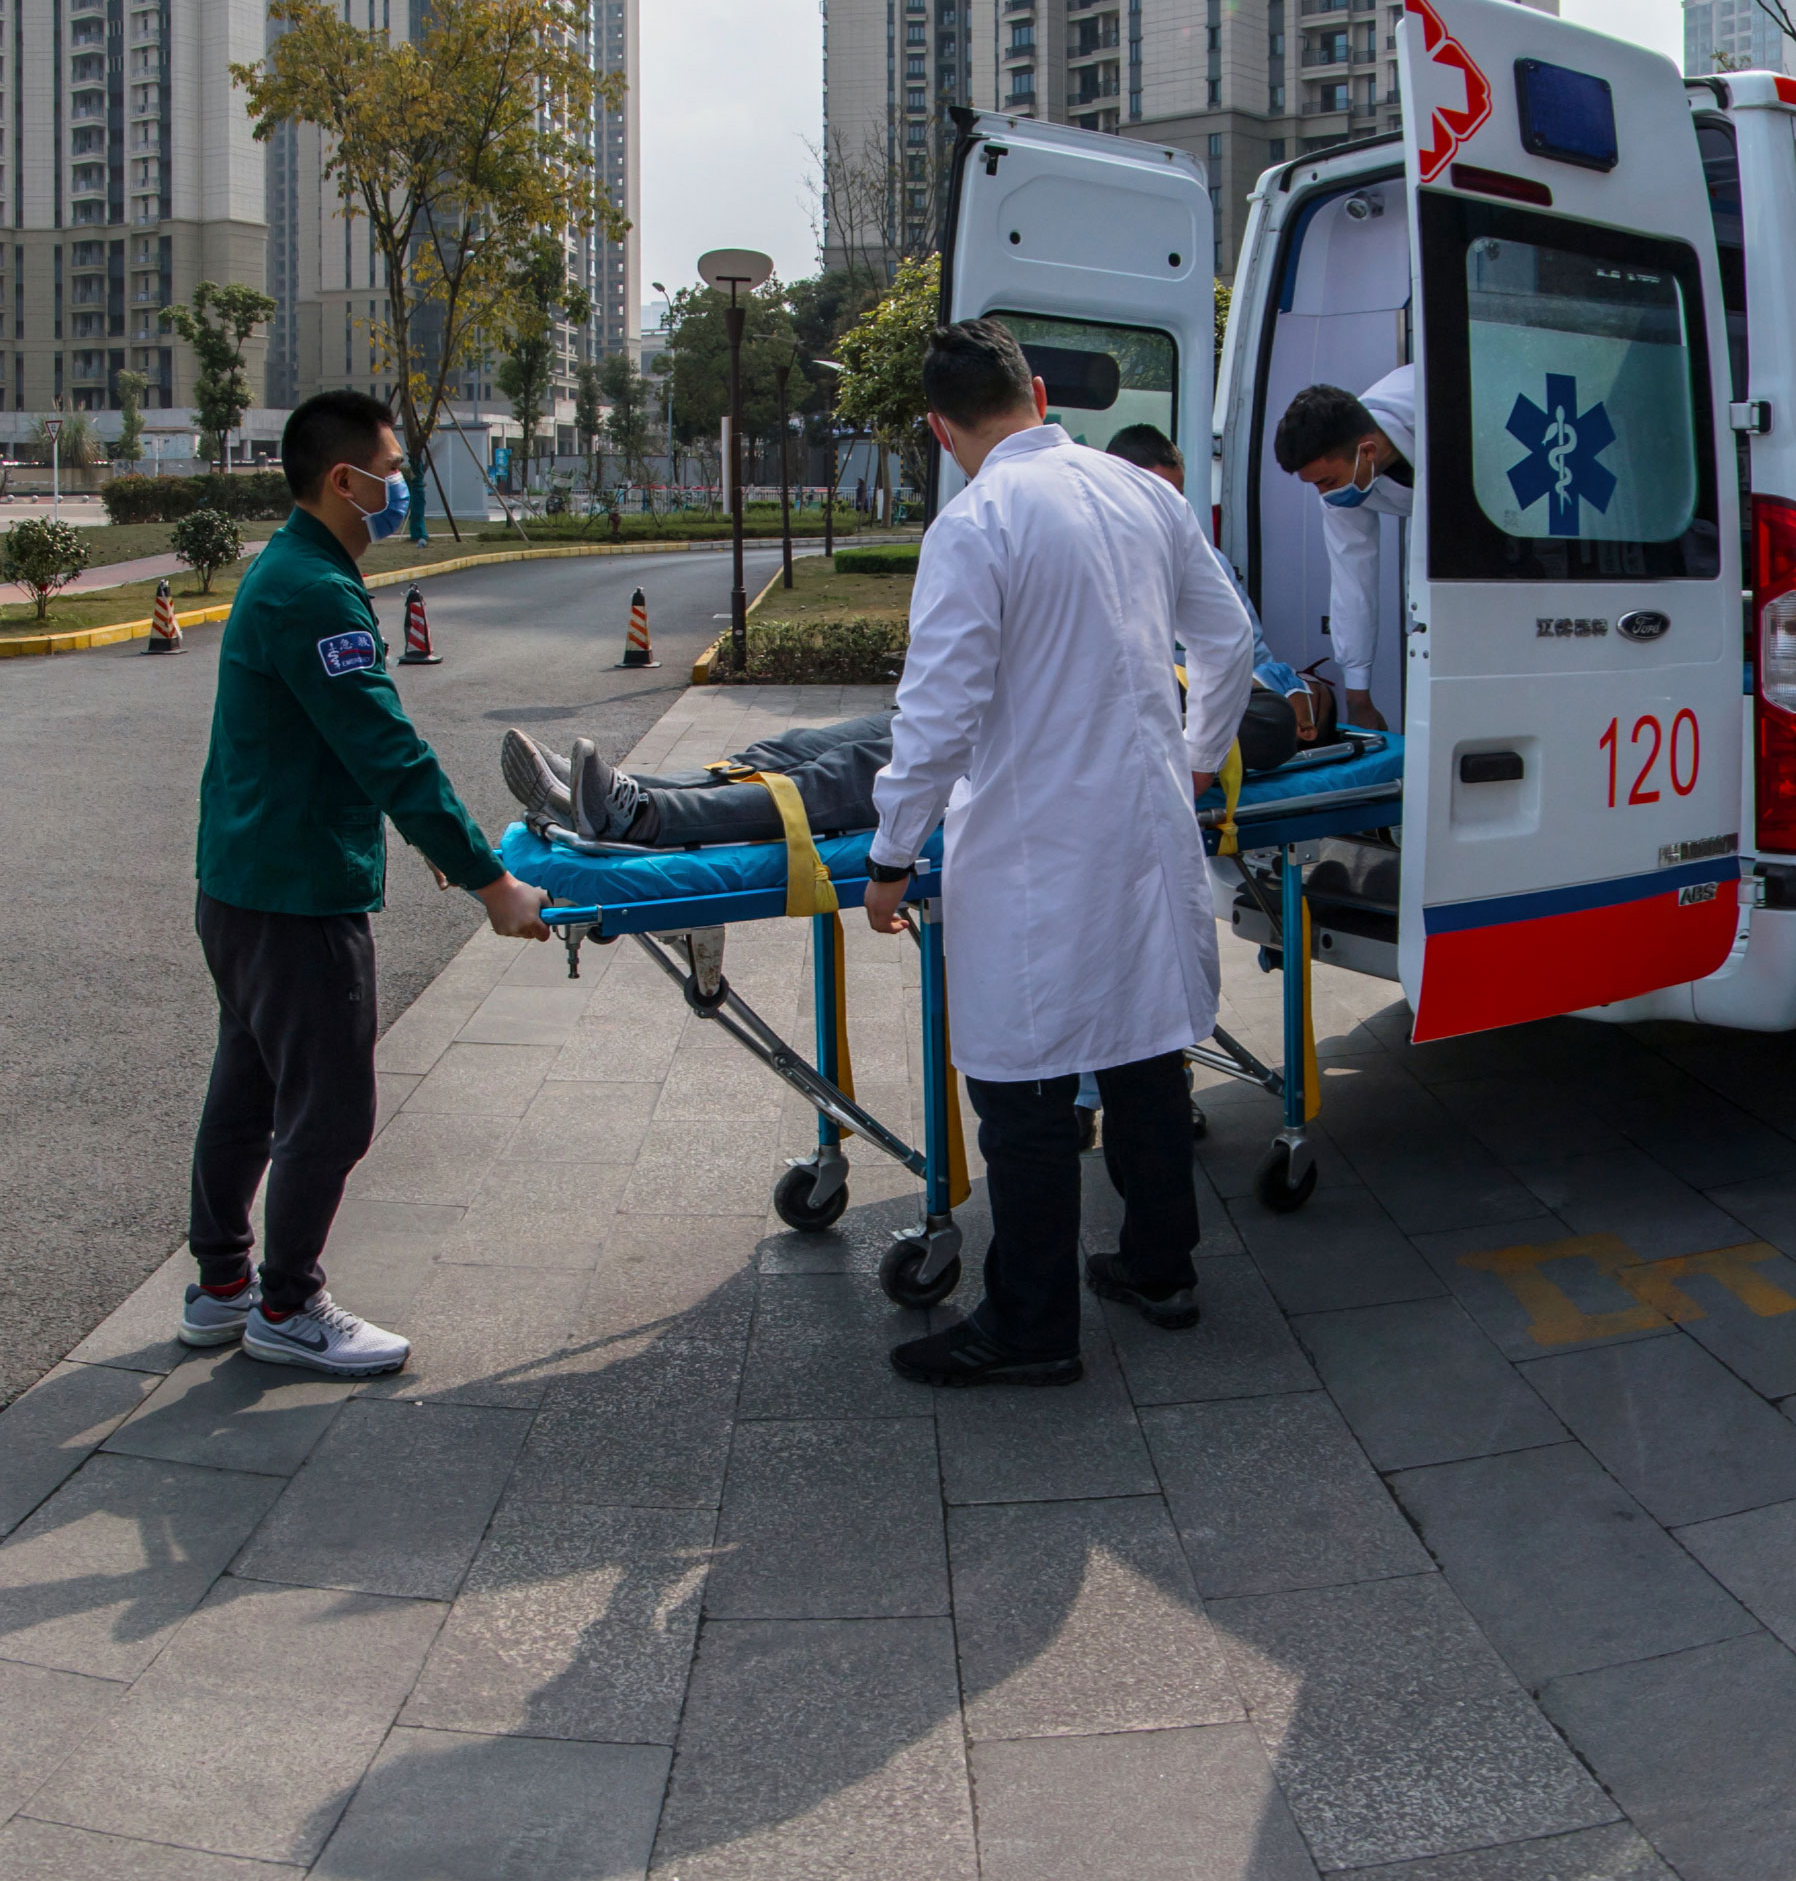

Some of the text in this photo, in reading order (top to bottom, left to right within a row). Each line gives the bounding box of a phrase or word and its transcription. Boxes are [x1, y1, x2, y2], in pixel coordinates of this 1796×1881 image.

[1632, 615, 1661, 635] Ford
[1599, 707, 1700, 809] 120
[1679, 882, 1717, 906] ABS
